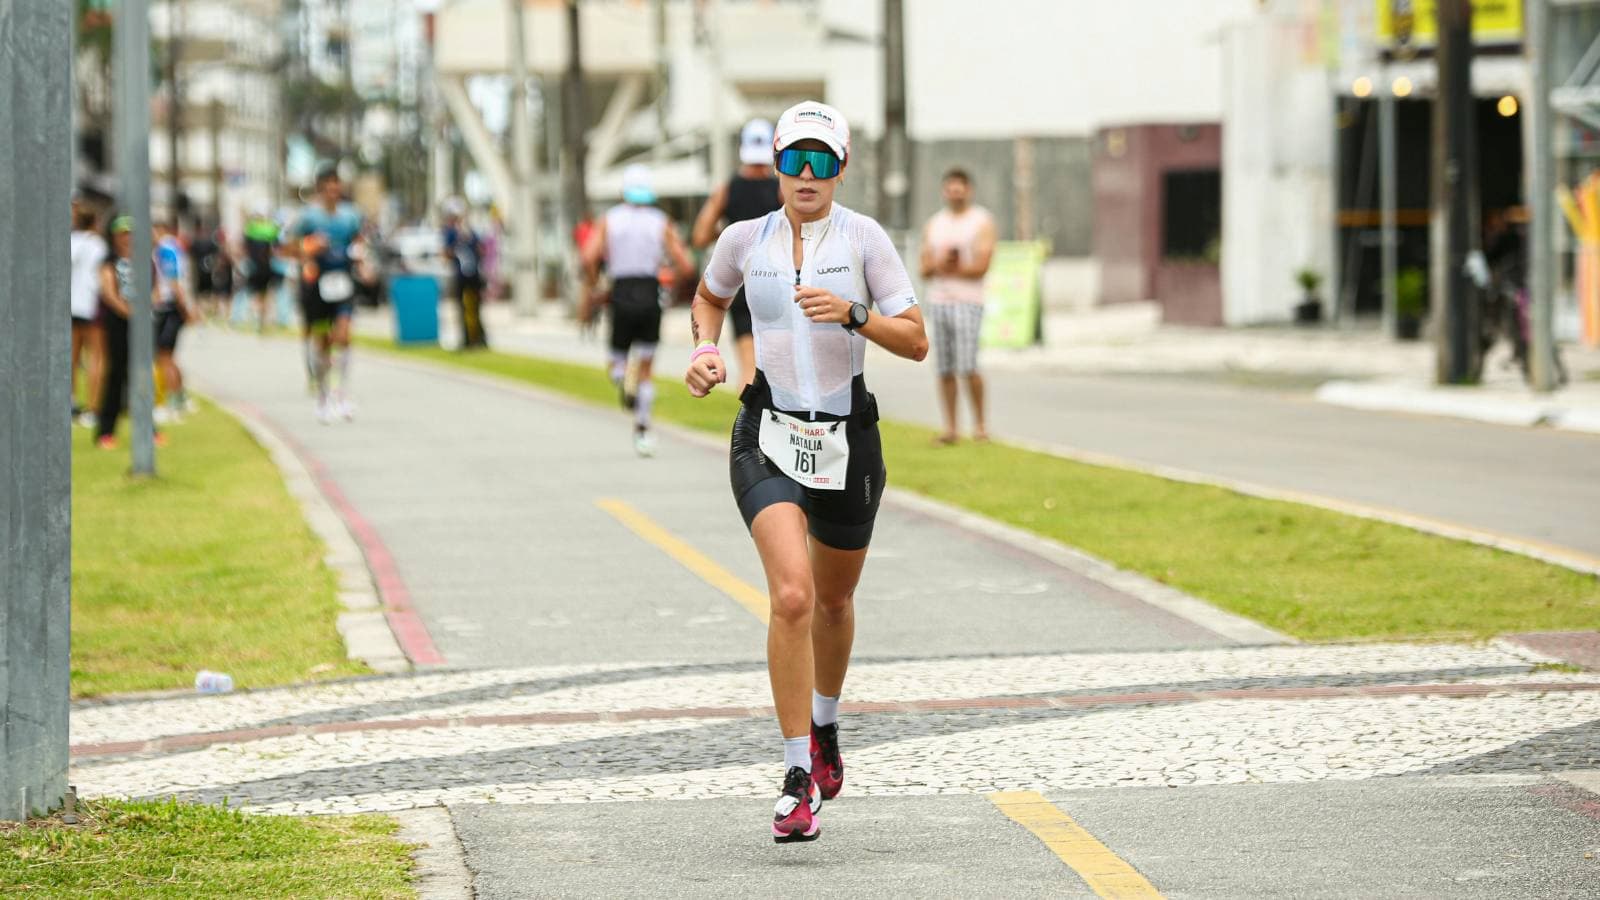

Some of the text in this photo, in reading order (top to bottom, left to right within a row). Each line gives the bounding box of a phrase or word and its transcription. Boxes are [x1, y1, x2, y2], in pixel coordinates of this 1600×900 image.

[751, 269, 778, 278] CARBON
[804, 427, 825, 437] HARD
[789, 433, 823, 451] NATALIA
[795, 449, 816, 475] 161
